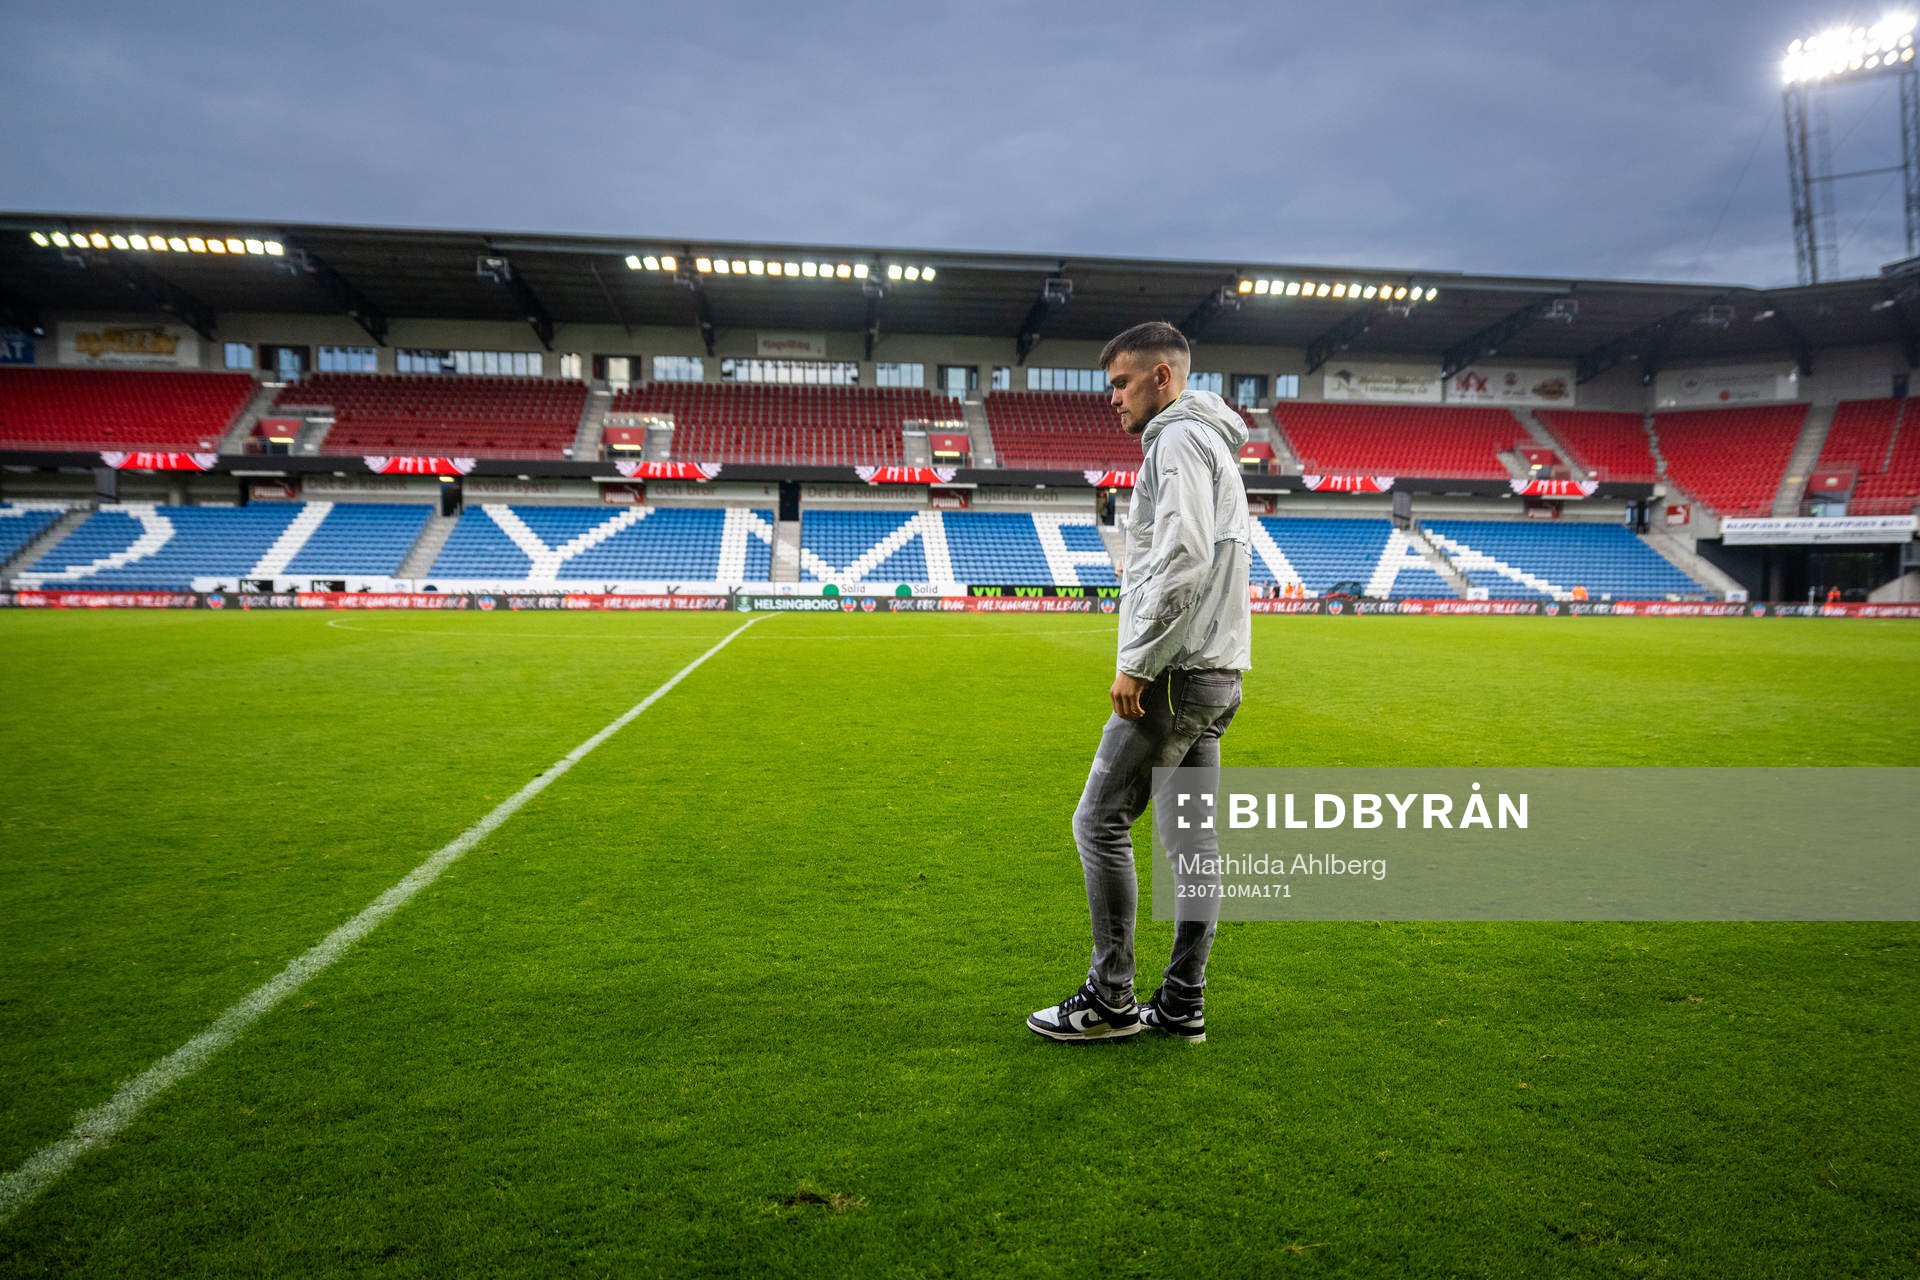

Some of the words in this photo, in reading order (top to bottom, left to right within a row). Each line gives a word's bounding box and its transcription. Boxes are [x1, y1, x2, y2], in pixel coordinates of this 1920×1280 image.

[840, 583, 867, 593] Solid
[914, 584, 938, 594] Solid
[753, 598, 839, 611] HELSINGBORG
